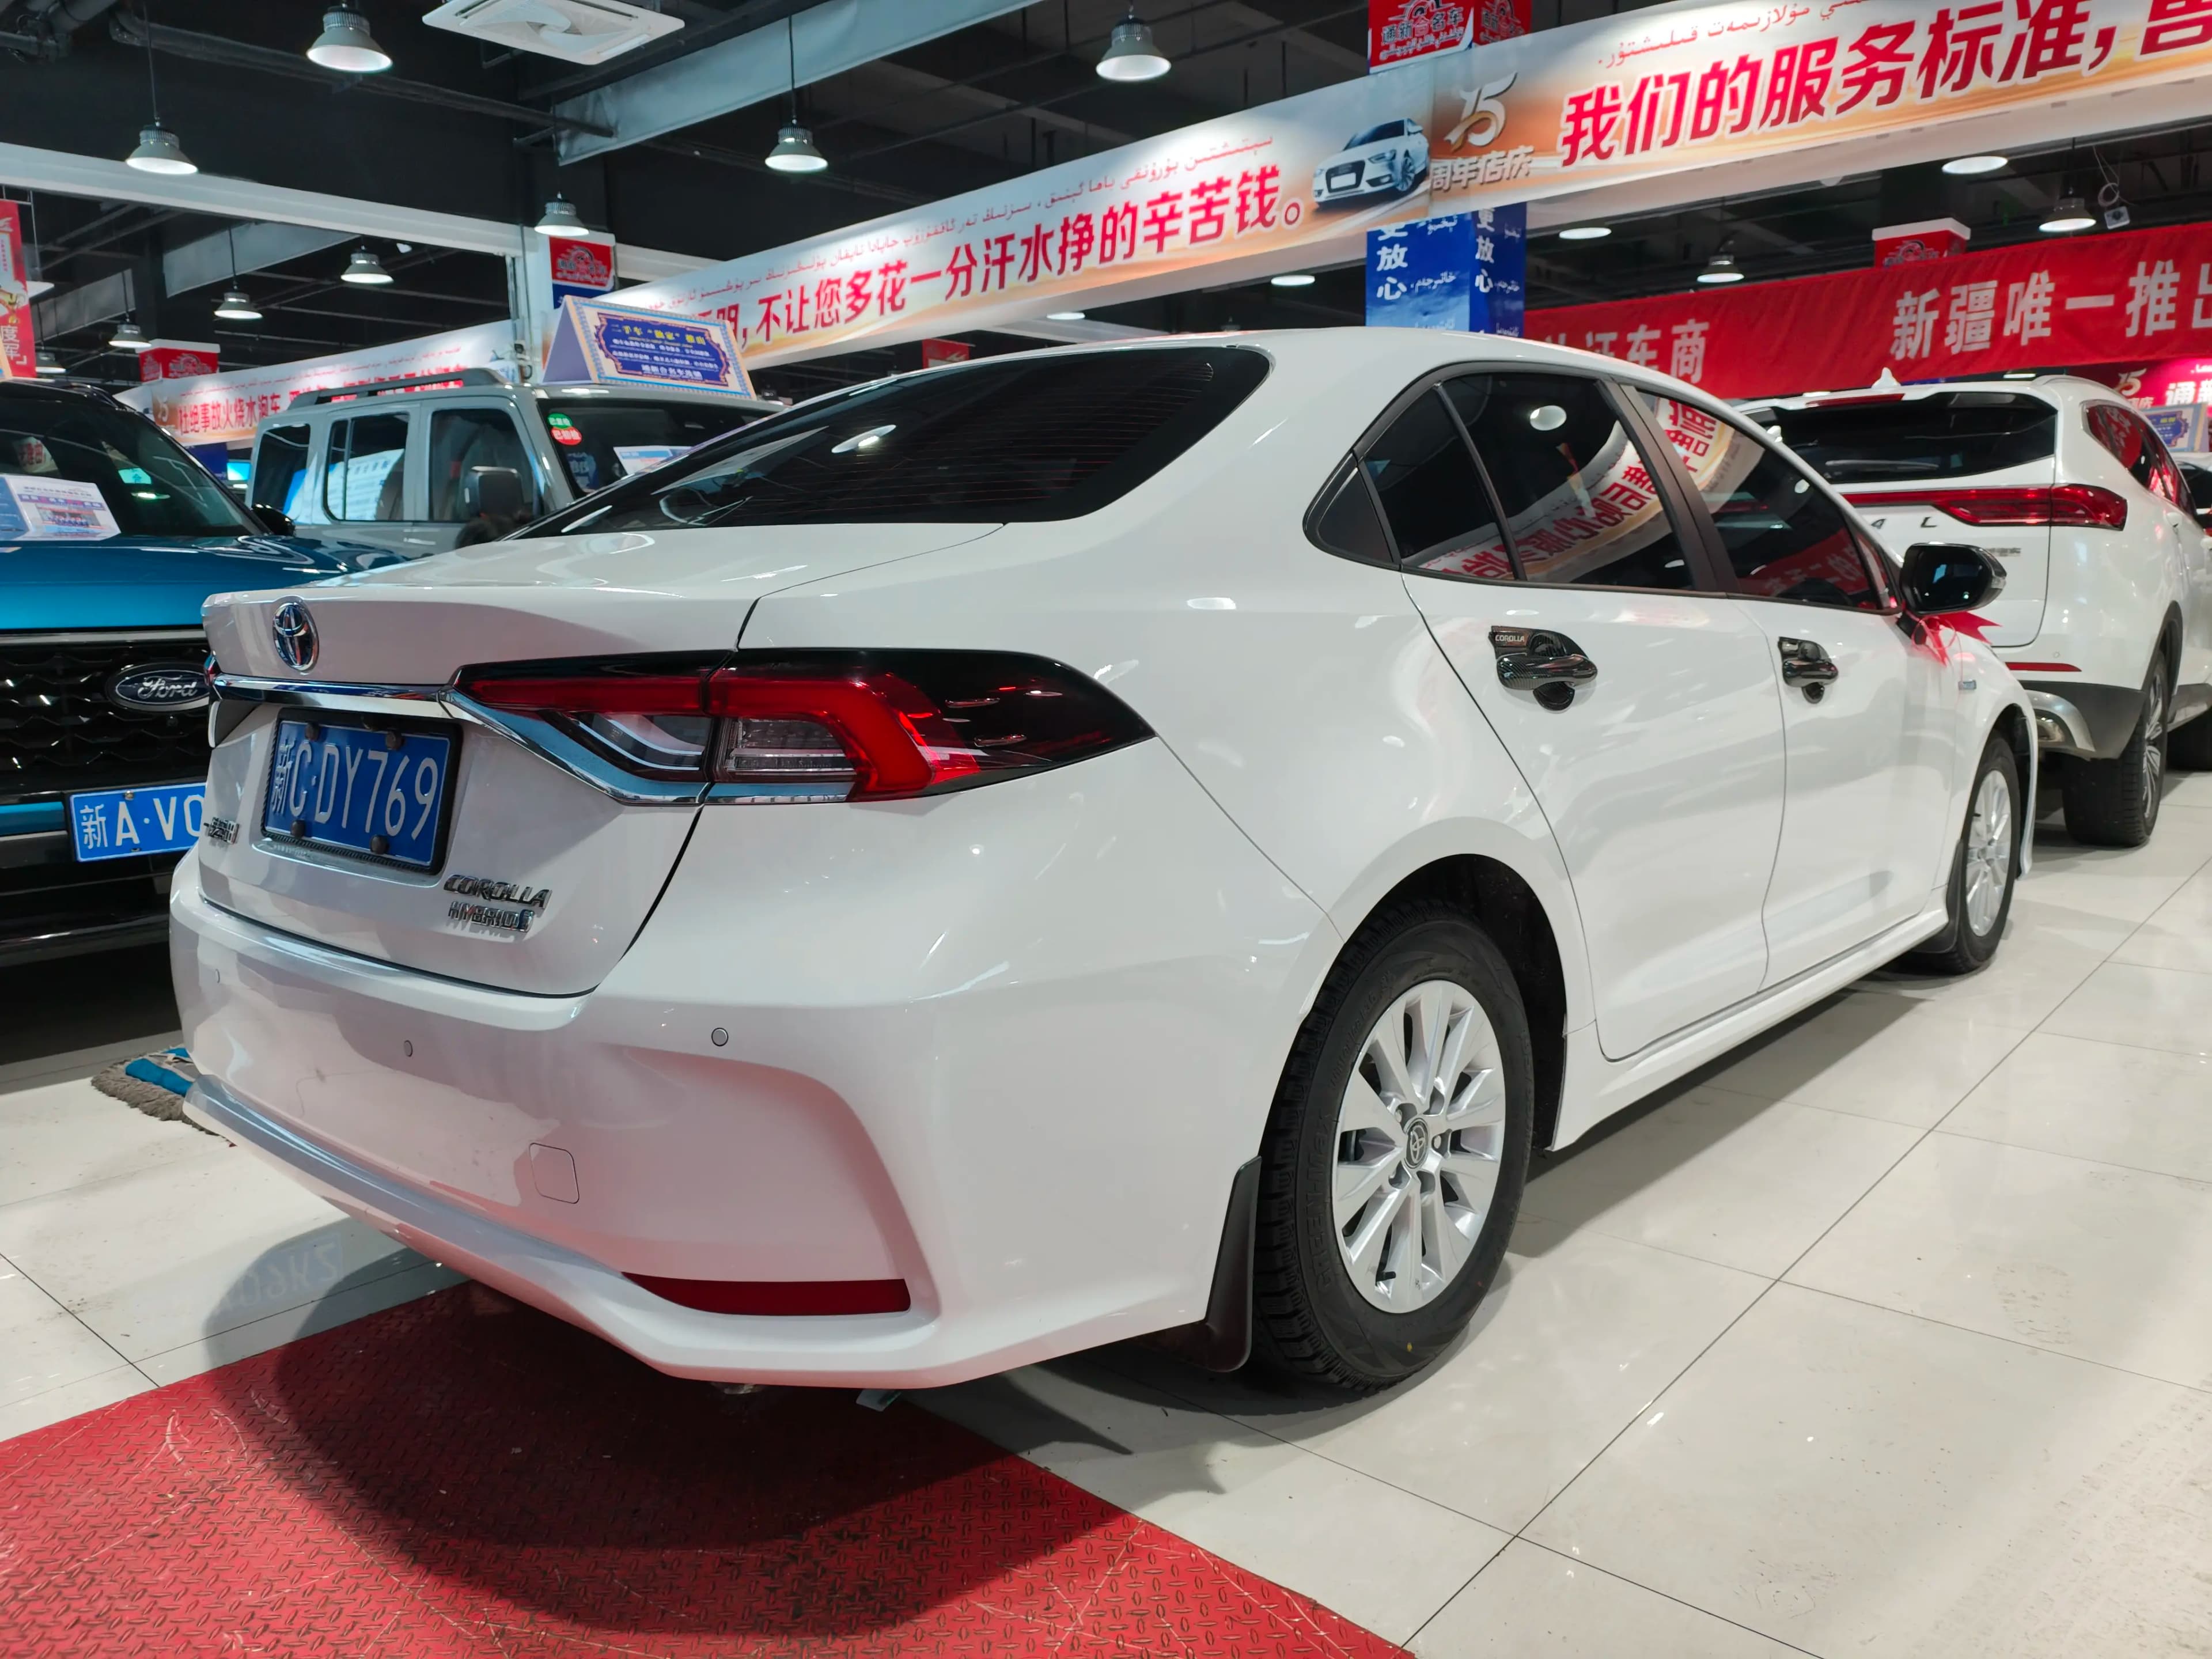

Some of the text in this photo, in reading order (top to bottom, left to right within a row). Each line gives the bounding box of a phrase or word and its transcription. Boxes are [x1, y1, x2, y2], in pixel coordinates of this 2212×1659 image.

[1429, 146, 1534, 193] 周年店庆
[1495, 634, 1525, 642] COROLLA
[138, 675, 197, 699] Ford
[444, 874, 553, 909] COROLLA
